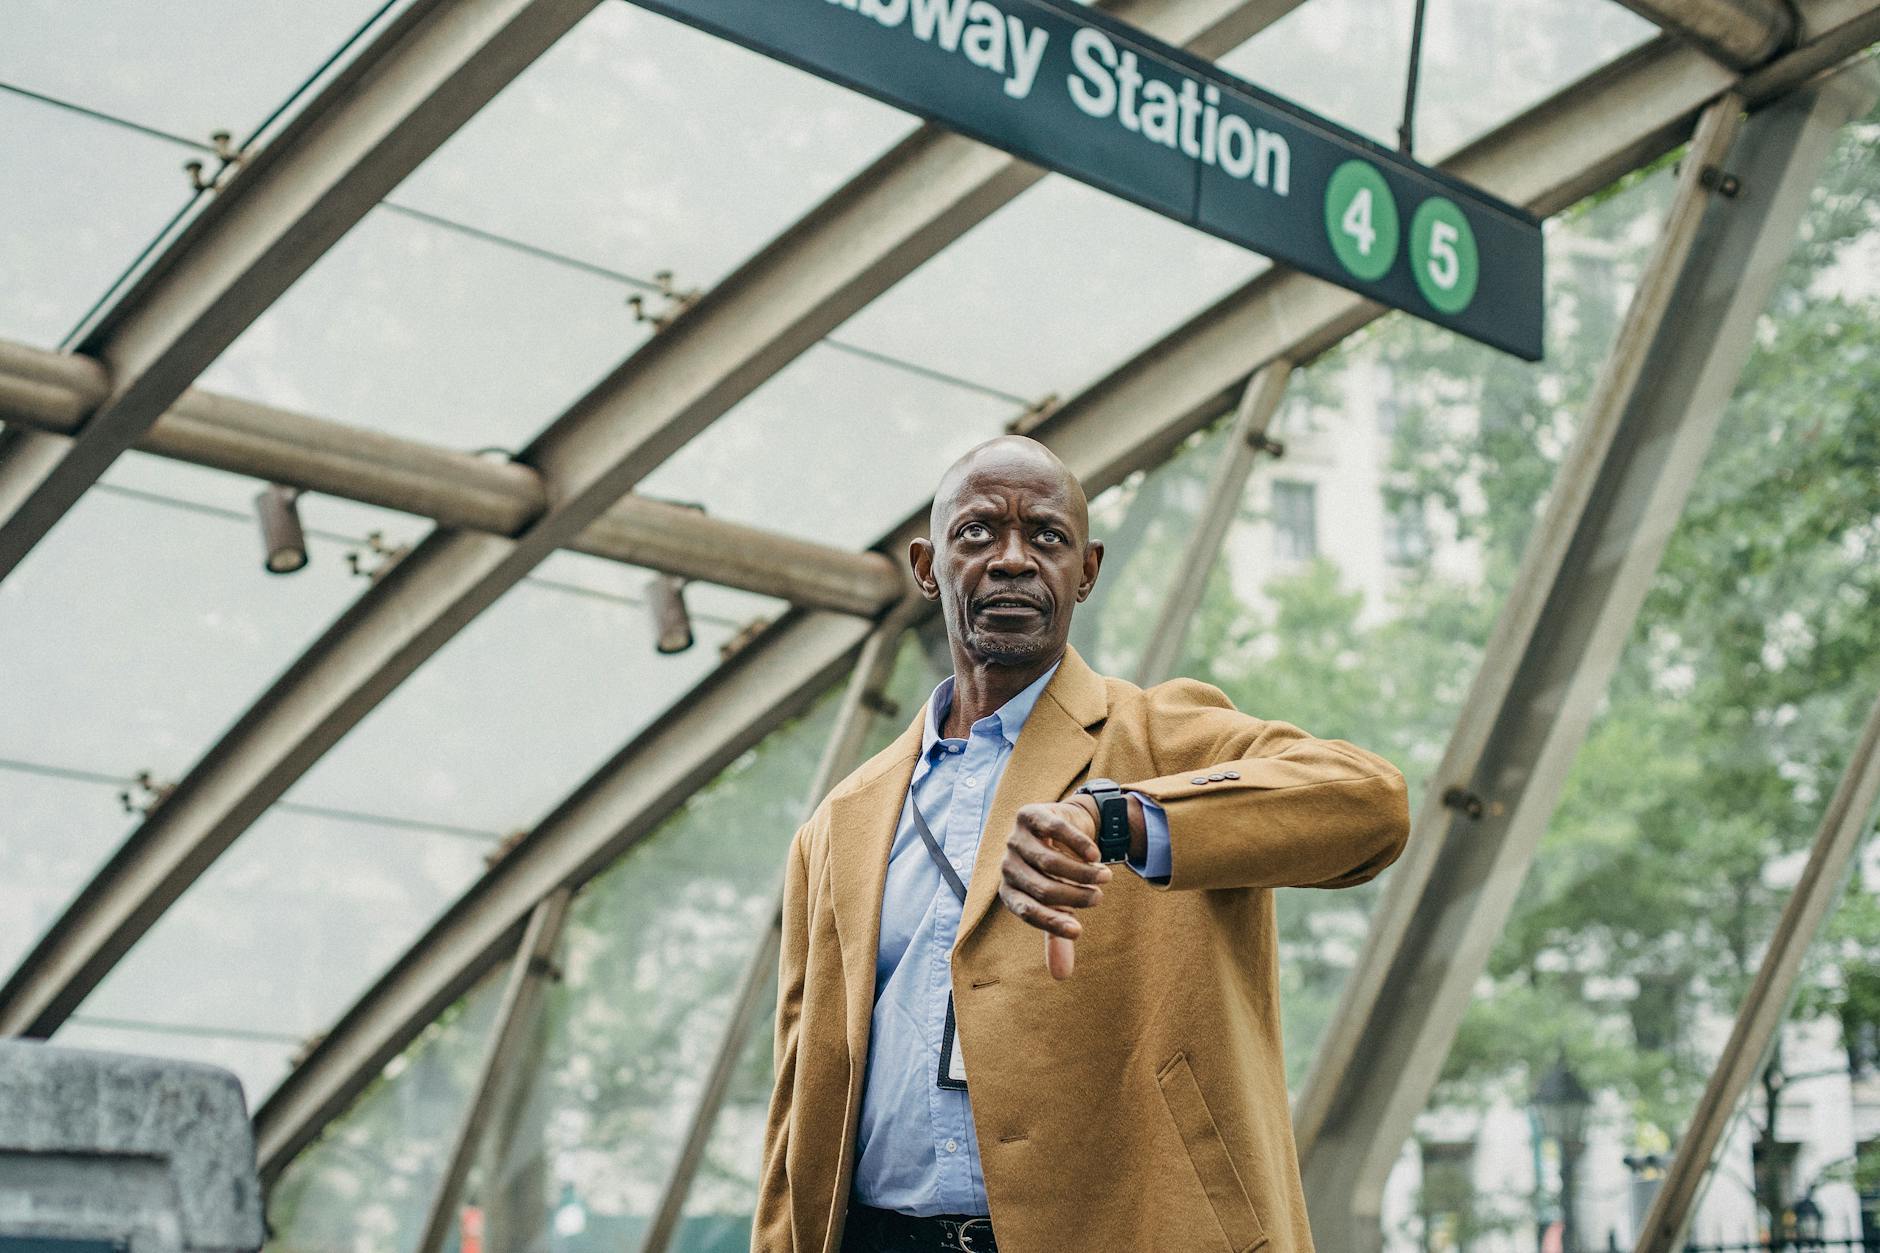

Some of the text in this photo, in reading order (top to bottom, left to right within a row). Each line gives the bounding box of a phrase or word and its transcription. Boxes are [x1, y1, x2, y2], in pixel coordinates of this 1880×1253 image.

[1067, 27, 1291, 196] Station
[1341, 187, 1378, 256] 4
[1427, 219, 1461, 291] 5
